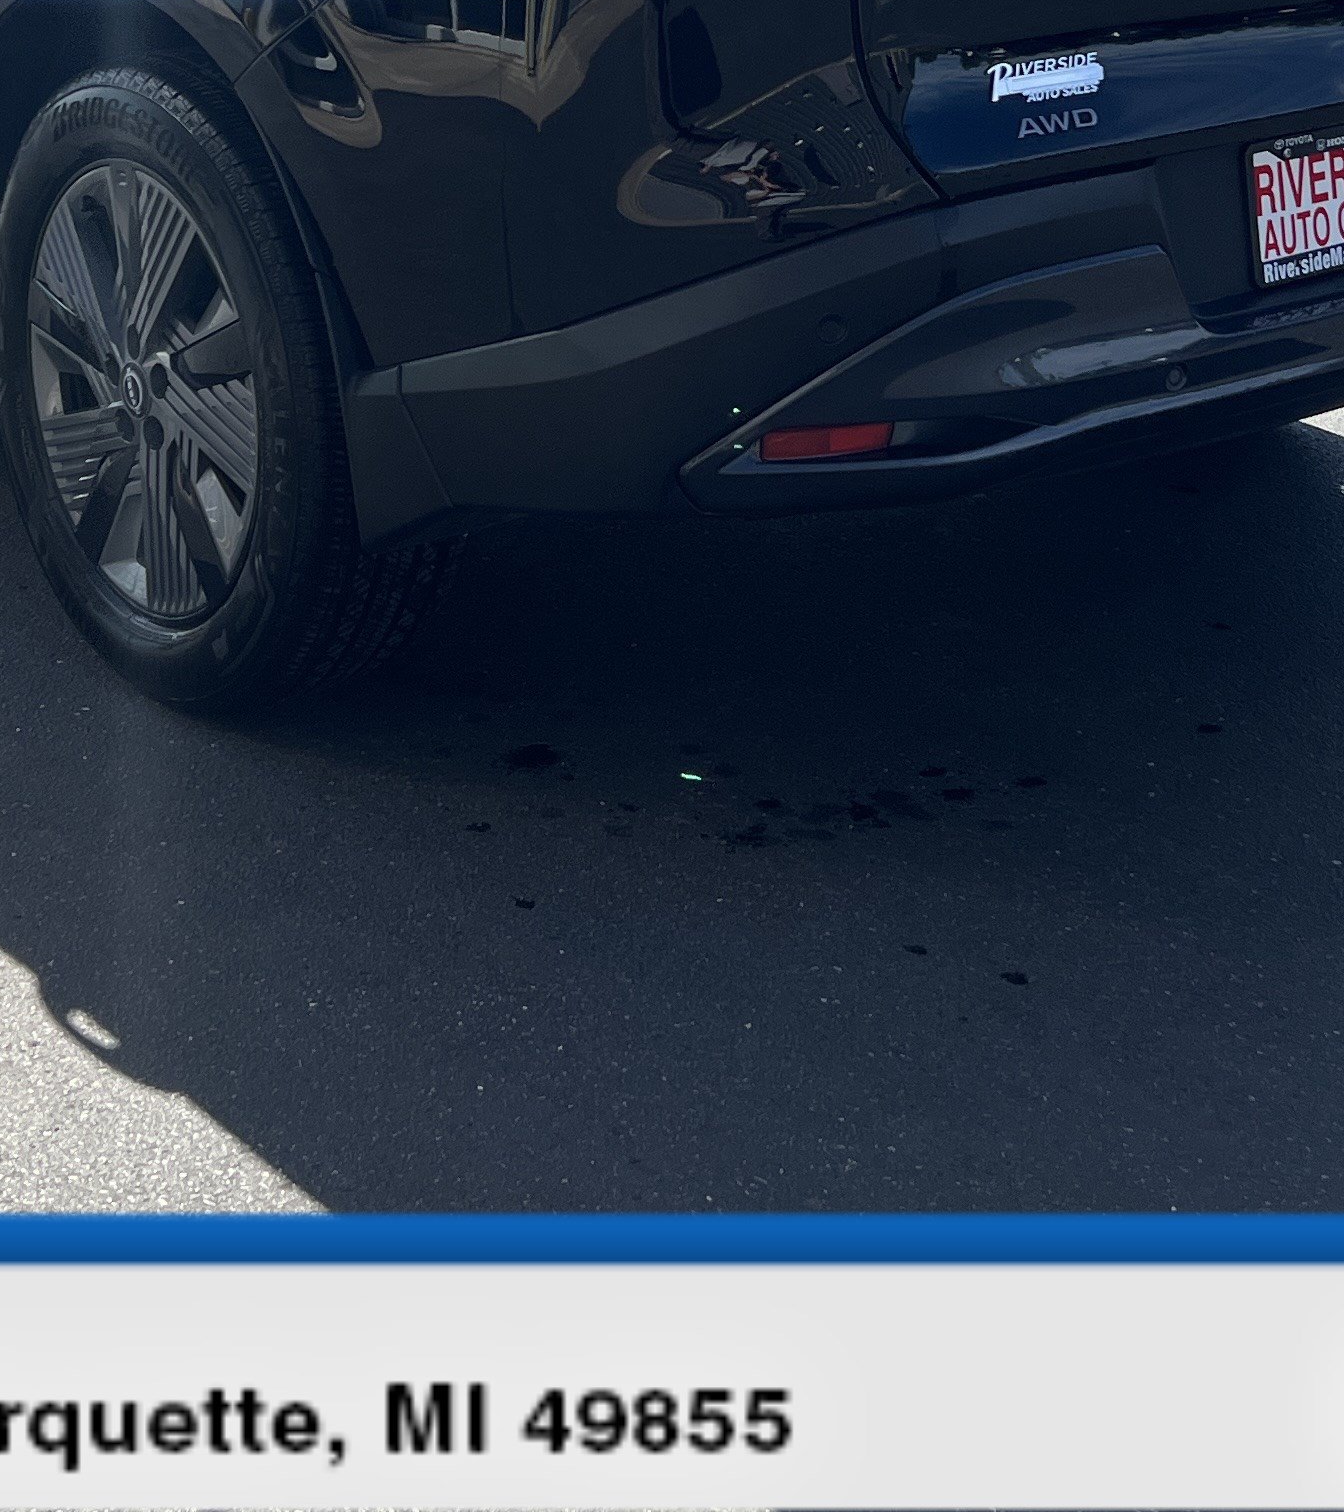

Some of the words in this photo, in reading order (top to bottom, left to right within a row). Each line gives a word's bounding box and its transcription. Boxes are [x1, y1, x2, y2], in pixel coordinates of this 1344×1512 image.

[987, 51, 1098, 102] RIVERSIDE
[1025, 87, 1061, 103] AUTO
[1062, 84, 1099, 97] SALES
[1017, 108, 1098, 139] AWD
[1285, 134, 1313, 146] TOYOTA
[1264, 207, 1331, 260] AUTO
